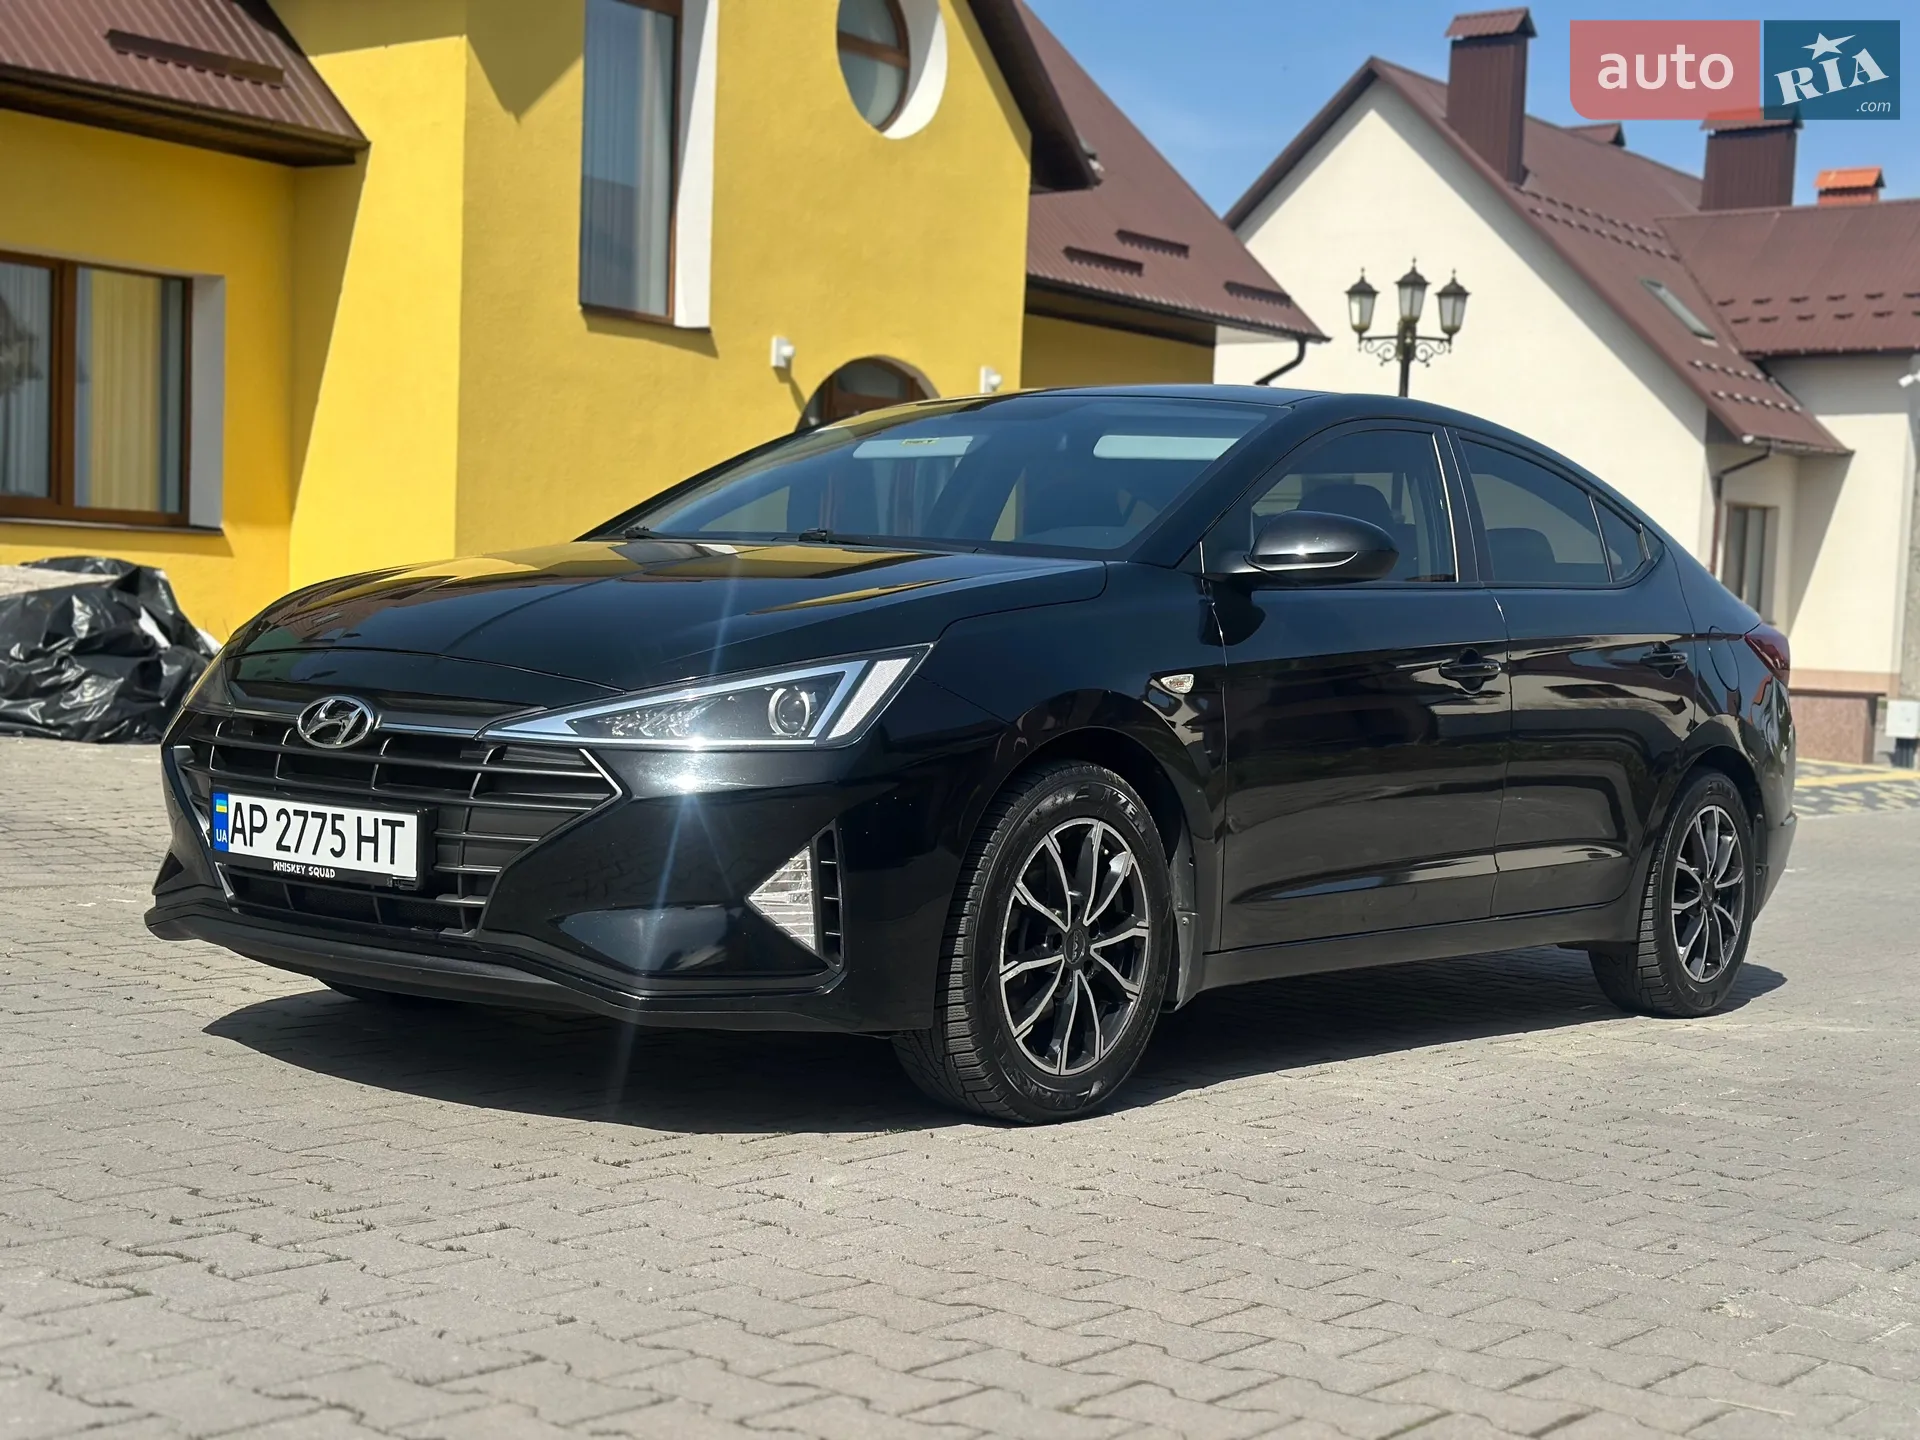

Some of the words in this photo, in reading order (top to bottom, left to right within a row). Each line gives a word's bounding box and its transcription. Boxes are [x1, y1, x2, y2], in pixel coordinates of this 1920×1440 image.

[216, 829, 228, 843] UA
[230, 802, 268, 847] AP
[275, 808, 346, 858] 2775
[356, 816, 405, 865] HT
[273, 860, 306, 875] WHISKEY
[308, 865, 336, 879] SQUAD
